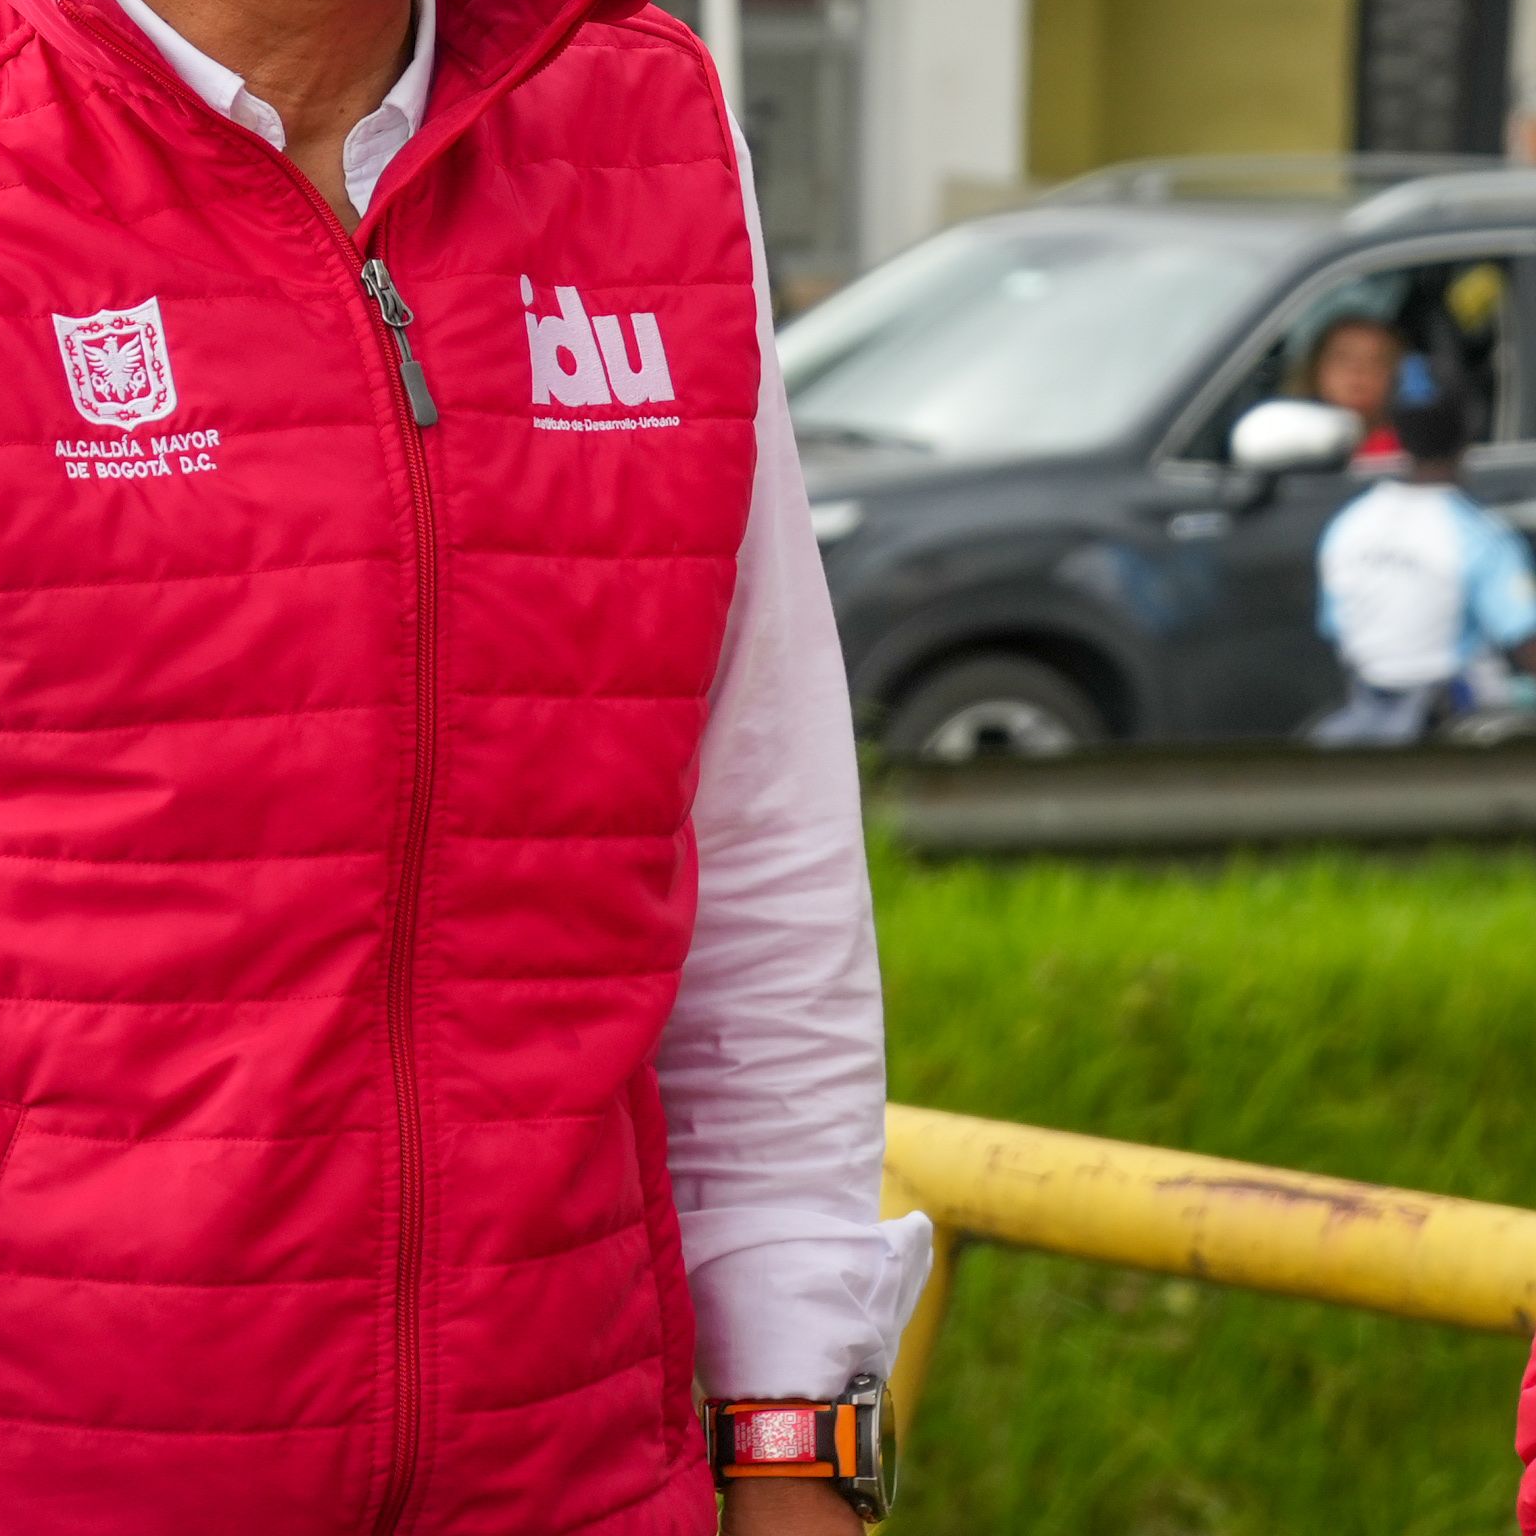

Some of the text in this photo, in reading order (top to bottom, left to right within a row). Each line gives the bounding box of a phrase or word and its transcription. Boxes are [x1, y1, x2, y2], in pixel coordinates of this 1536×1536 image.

[519, 273, 676, 408] idu
[55, 428, 221, 458] ALCALDÍA MAYOR
[65, 452, 218, 479] DE BOGOTÁ D.C.
